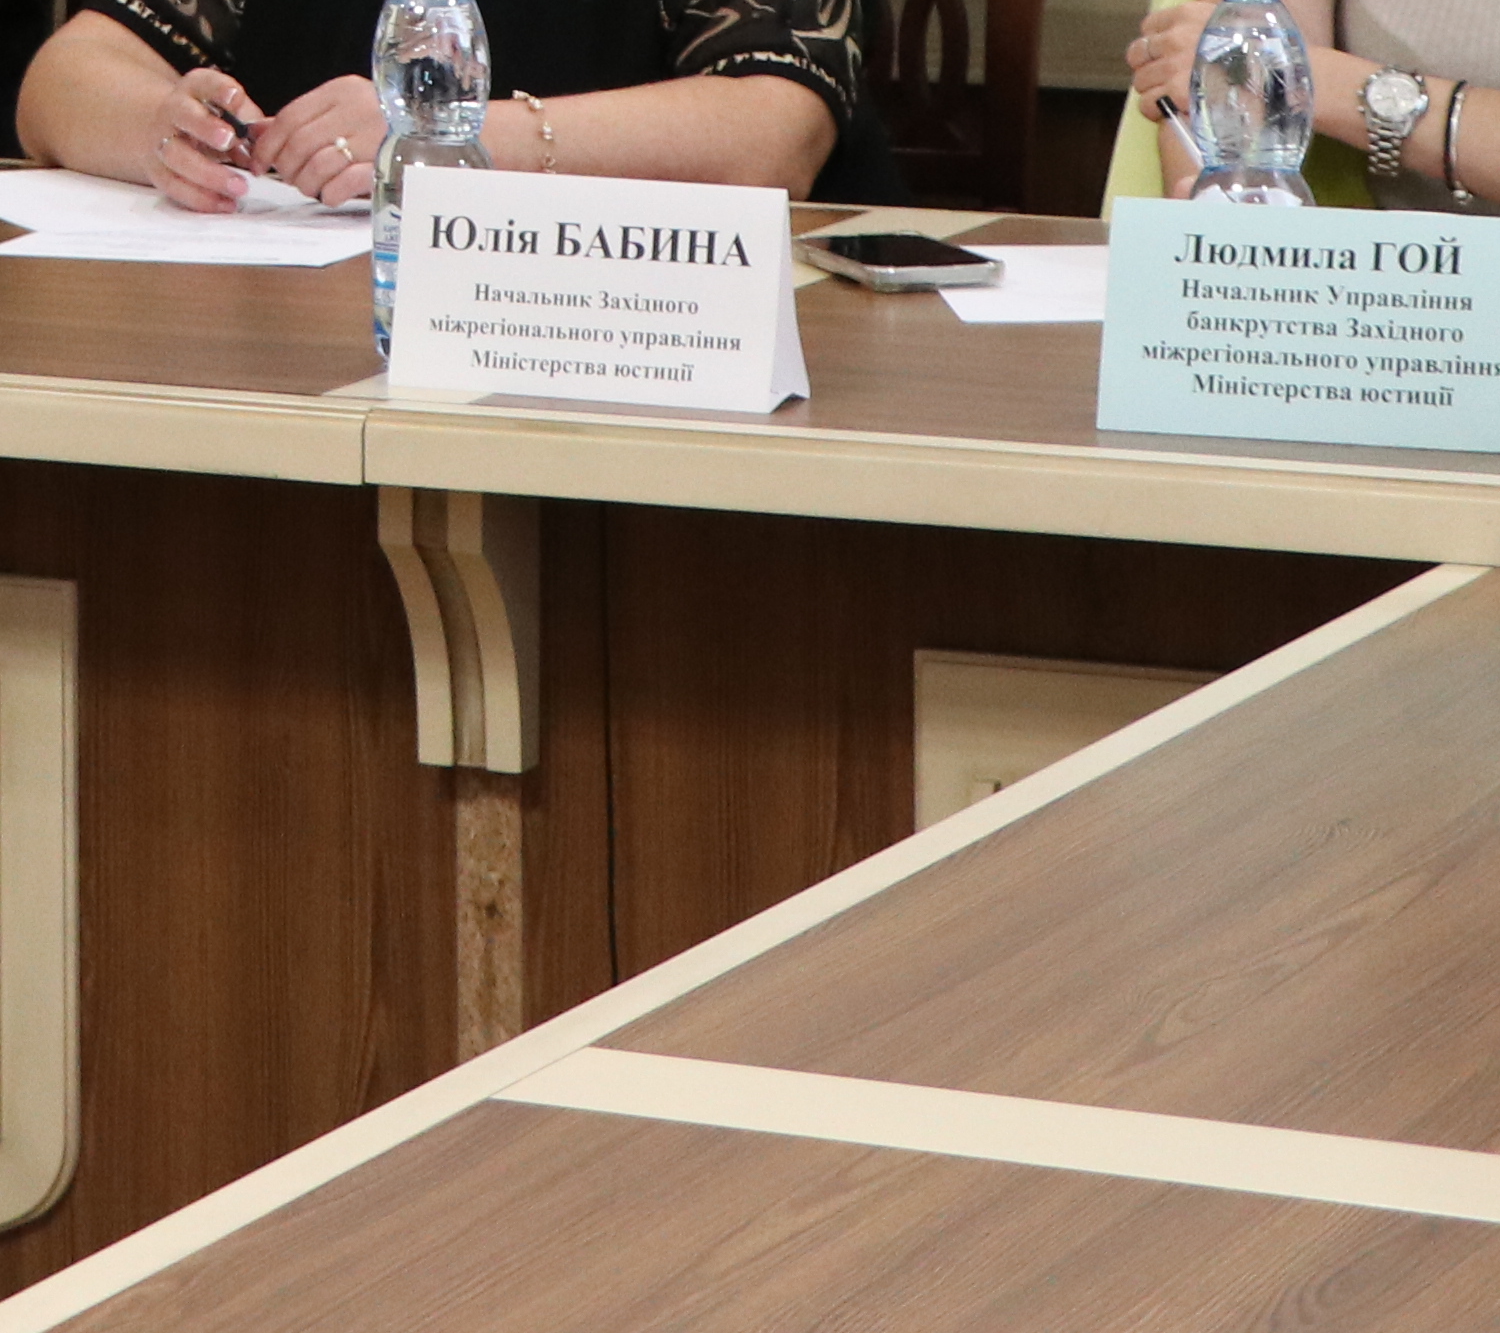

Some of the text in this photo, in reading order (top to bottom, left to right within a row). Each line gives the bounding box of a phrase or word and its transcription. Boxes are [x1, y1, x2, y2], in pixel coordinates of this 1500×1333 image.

[429, 214, 751, 267] Юлія БАБИНА
[1175, 233, 1463, 275] Людмила ГОЙ
[475, 283, 698, 316] Начальник Західного
[1181, 279, 1473, 313] Начальник Управління
[430, 316, 741, 353] міжрегіонального управління
[1187, 311, 1464, 343] банкрутства Західного
[471, 350, 694, 383] Міністерства юстиції
[1142, 341, 1358, 371] міжрегіонального
[1192, 374, 1454, 409] Міністерства юстиції
